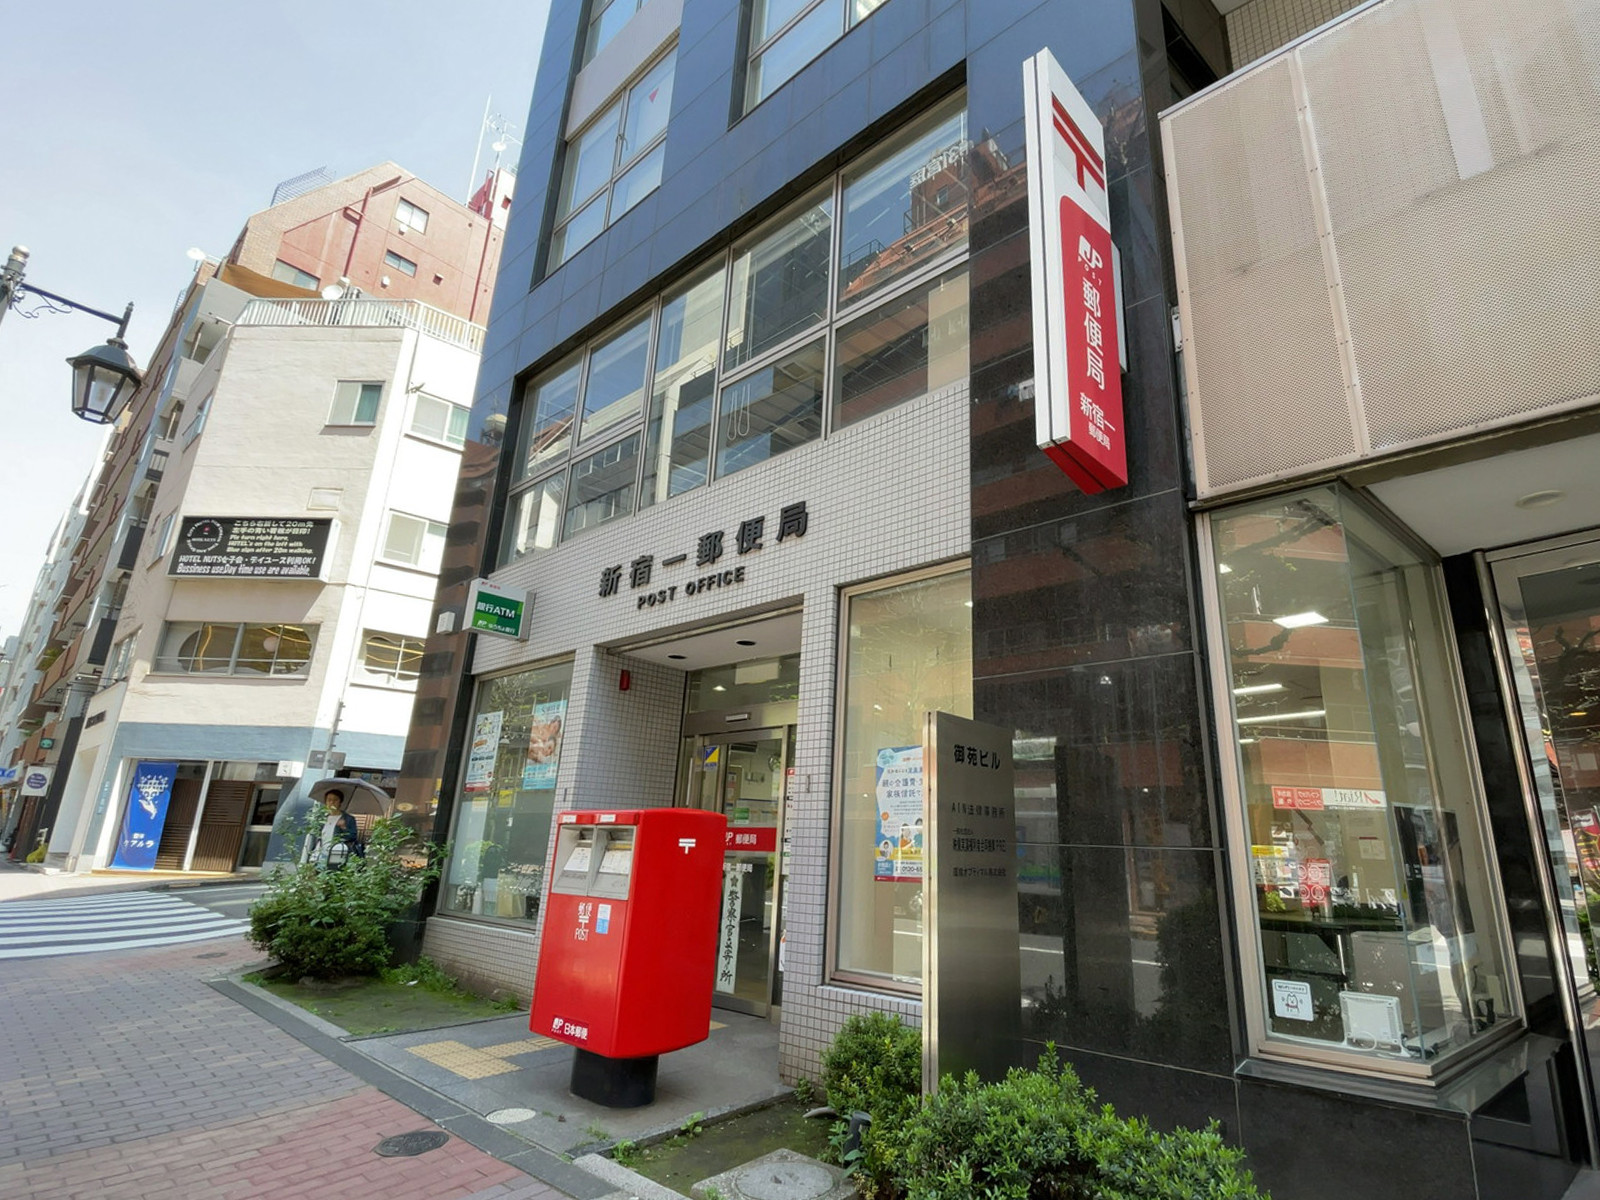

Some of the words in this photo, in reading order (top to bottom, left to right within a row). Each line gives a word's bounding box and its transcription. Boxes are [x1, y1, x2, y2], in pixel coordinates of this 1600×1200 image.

[1082, 277, 1105, 391] 郵便局
[1080, 392, 1115, 431] 新宿一
[1088, 421, 1110, 451] 郵便局
[178, 555, 202, 563] HOTEL
[599, 501, 809, 598] 新宿一郵便局
[253, 565, 267, 575] use
[267, 566, 280, 575] are
[637, 586, 677, 610] POST
[684, 565, 746, 597] OFFICE
[476, 602, 516, 618] 銀行ATM
[953, 744, 1001, 770] 御苑ビル
[578, 902, 592, 917] 郵便
[574, 927, 590, 941] POST
[564, 1022, 588, 1040] 日本郵便
